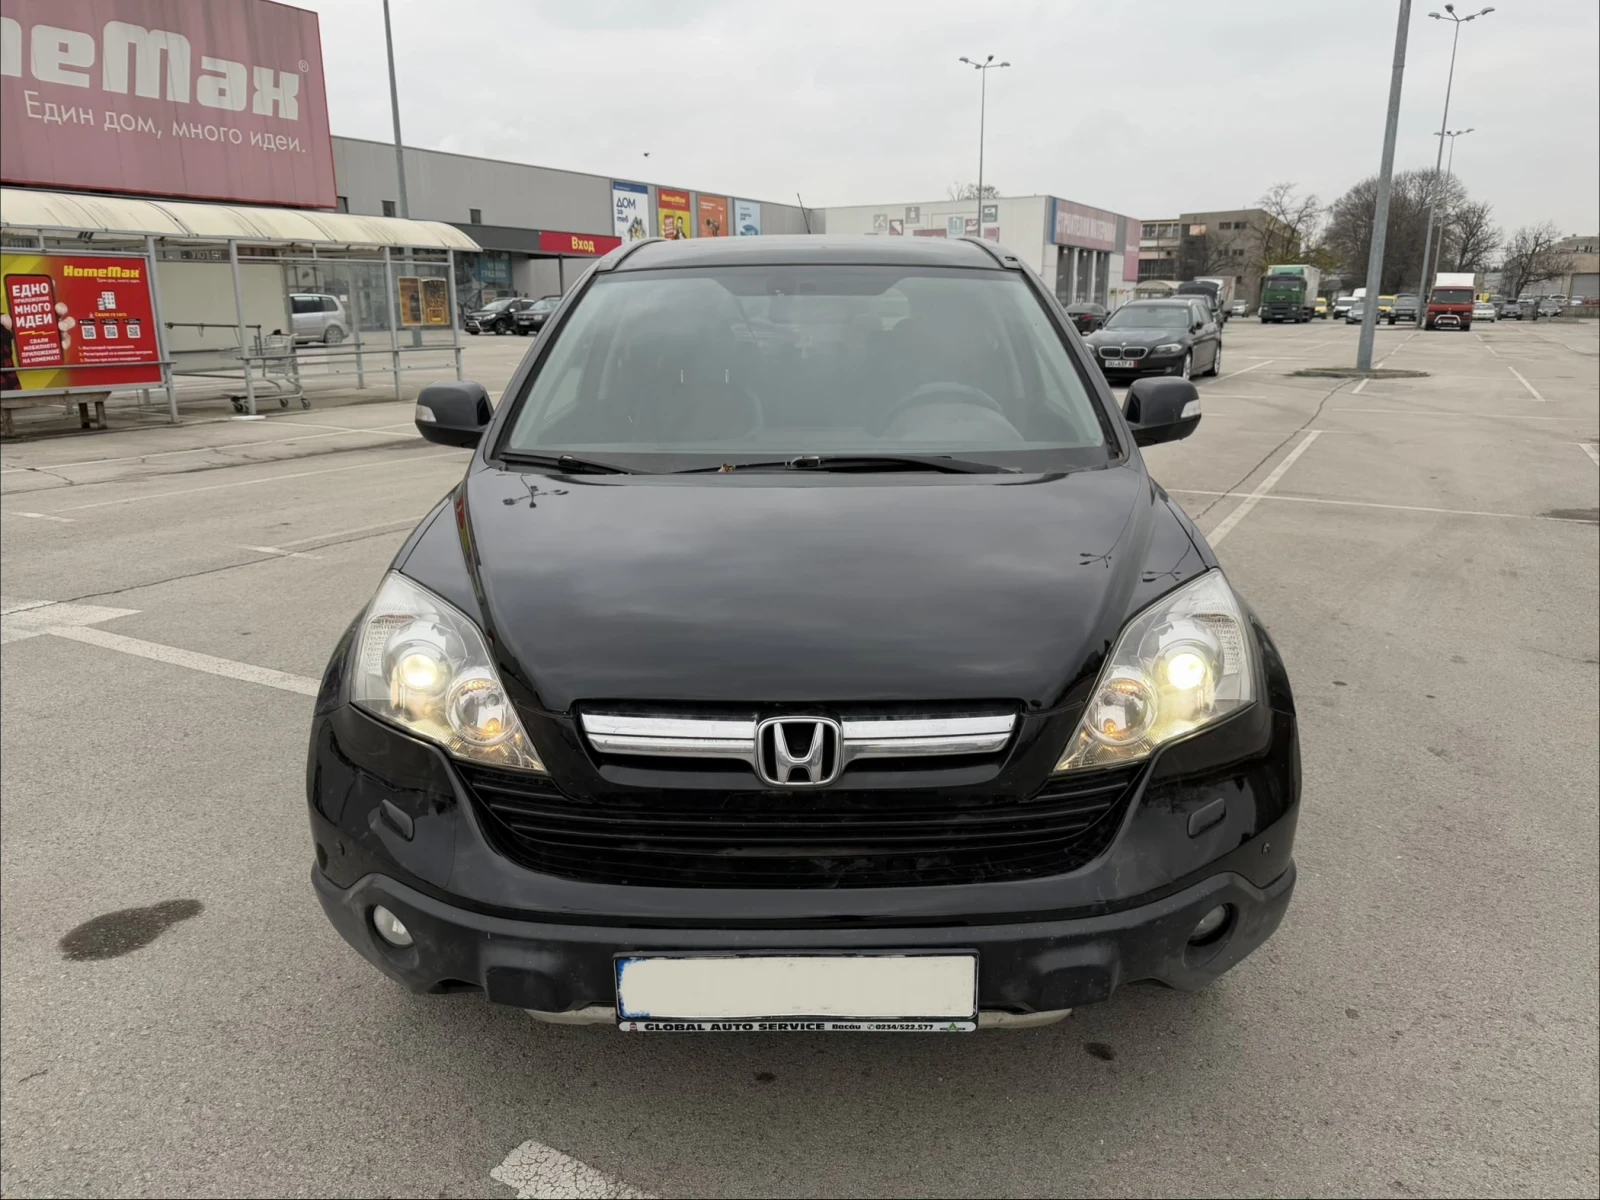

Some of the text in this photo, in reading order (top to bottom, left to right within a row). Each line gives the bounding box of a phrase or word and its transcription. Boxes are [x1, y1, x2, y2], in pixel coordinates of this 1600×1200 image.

[0, 16, 299, 120] eMax
[24, 90, 306, 153] Един дом, много идеи.
[571, 236, 595, 252] Вход
[63, 265, 140, 278] HomeMax
[12, 283, 49, 298] ЕДНО
[14, 302, 51, 315] МНОГО
[16, 314, 52, 328] ИДЕИ
[644, 1023, 705, 1031] GLOBAL
[710, 1023, 754, 1031] AUTO
[758, 1022, 825, 1031] SERVICE
